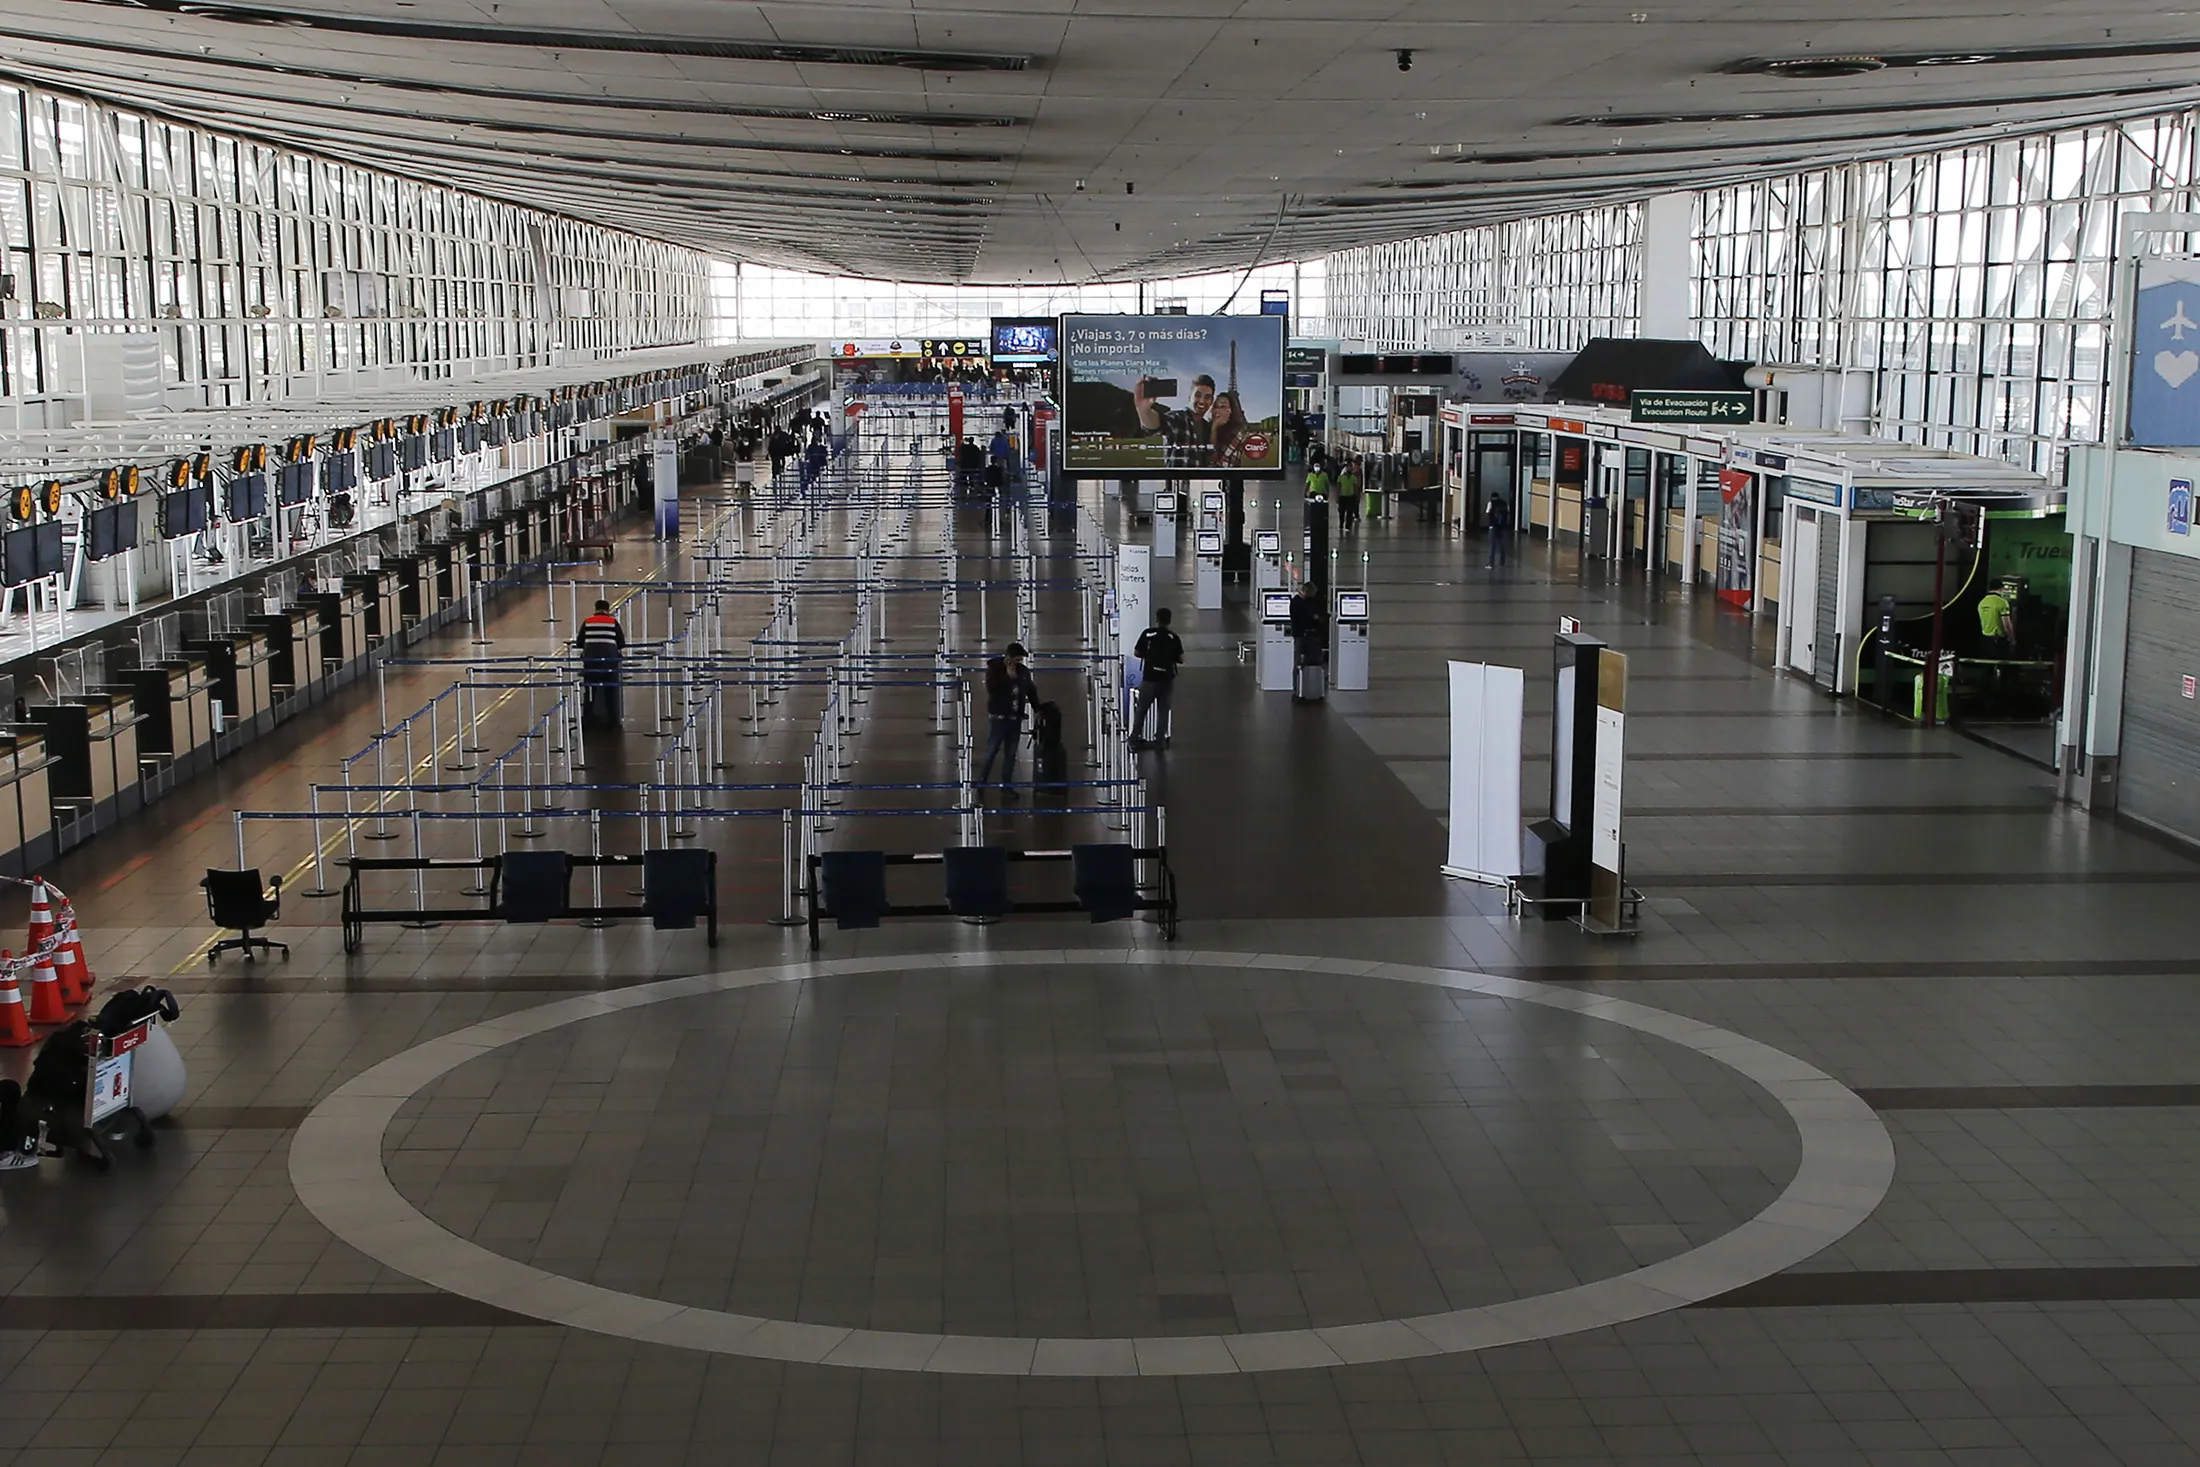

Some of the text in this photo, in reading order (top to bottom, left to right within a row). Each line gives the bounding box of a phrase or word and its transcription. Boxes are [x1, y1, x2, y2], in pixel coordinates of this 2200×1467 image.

[1070, 328, 1207, 342] ¿Viajas 3, 7 o más días?
[1070, 343, 1145, 356] ¡No importa!
[1653, 398, 1664, 406] de
[1641, 408, 1708, 417] Evacuation Route
[1244, 442, 1265, 451] Claro
